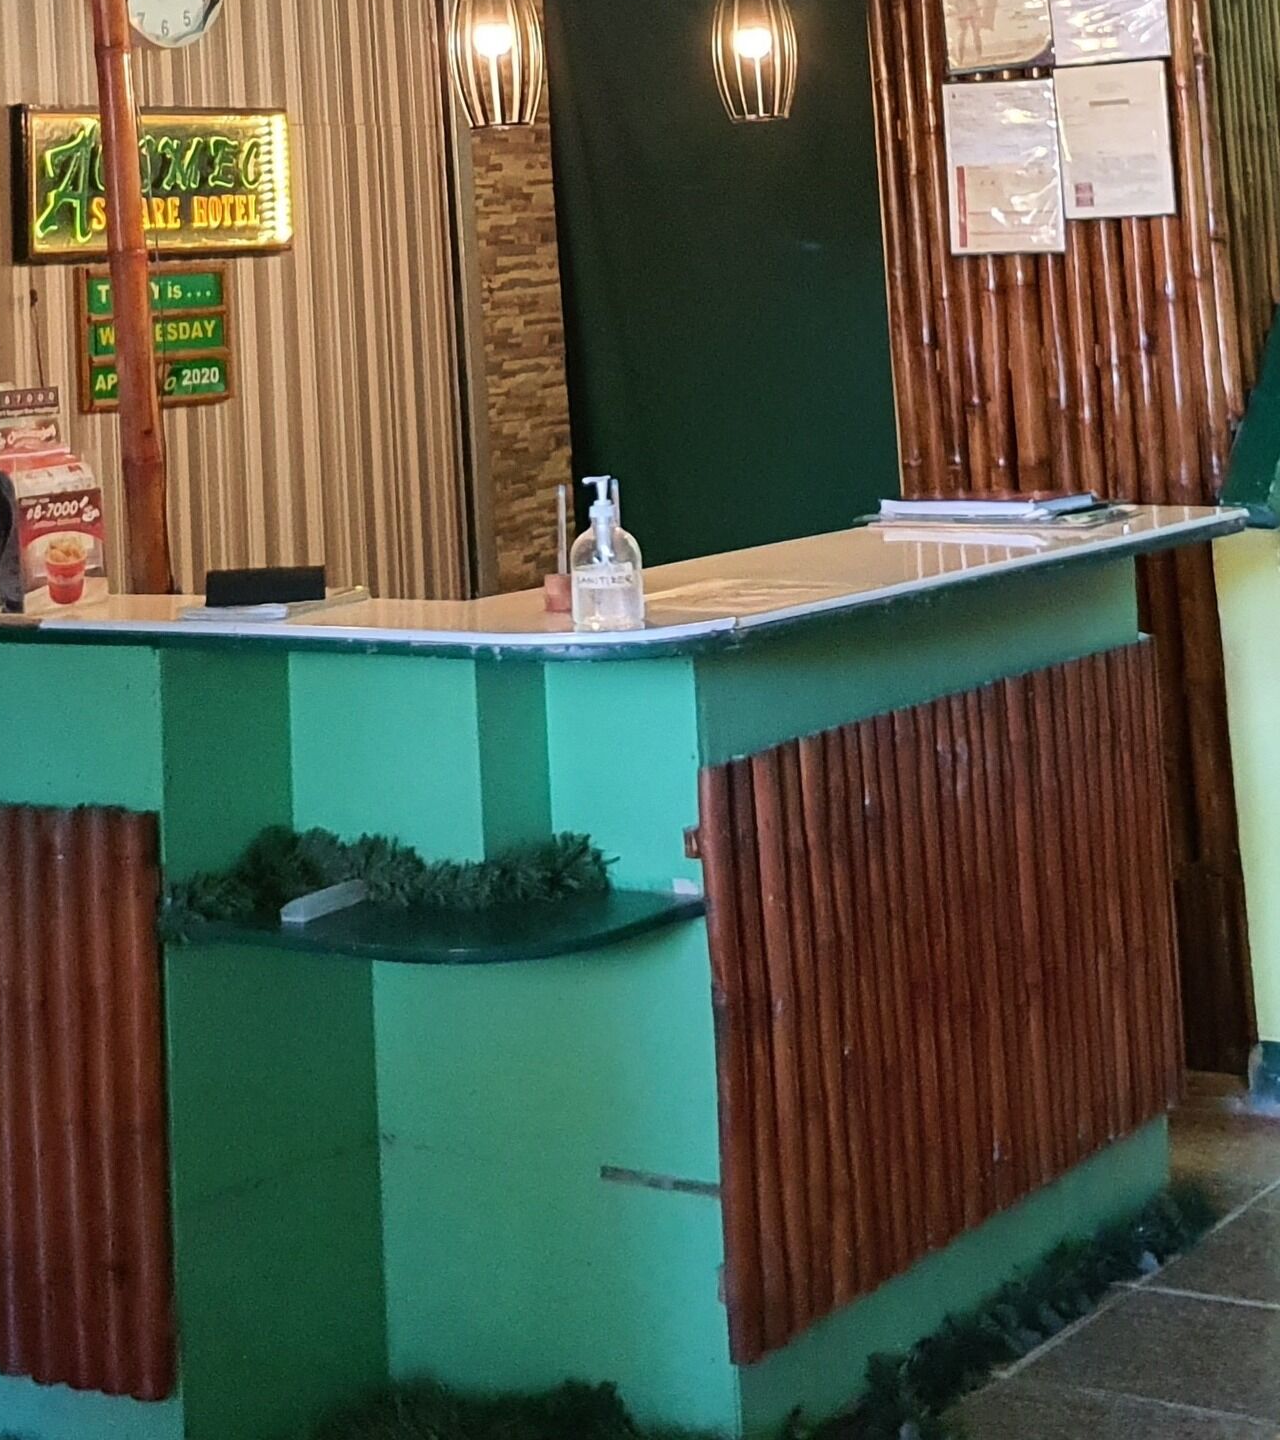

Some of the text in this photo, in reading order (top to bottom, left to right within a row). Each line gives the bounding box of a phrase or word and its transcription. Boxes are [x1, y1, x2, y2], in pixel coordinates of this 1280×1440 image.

[161, 19, 169, 37] 6
[183, 9, 192, 27] 5
[91, 193, 261, 230] SARE HOTEL
[99, 319, 216, 347] WESDAY
[182, 365, 220, 387] 2020
